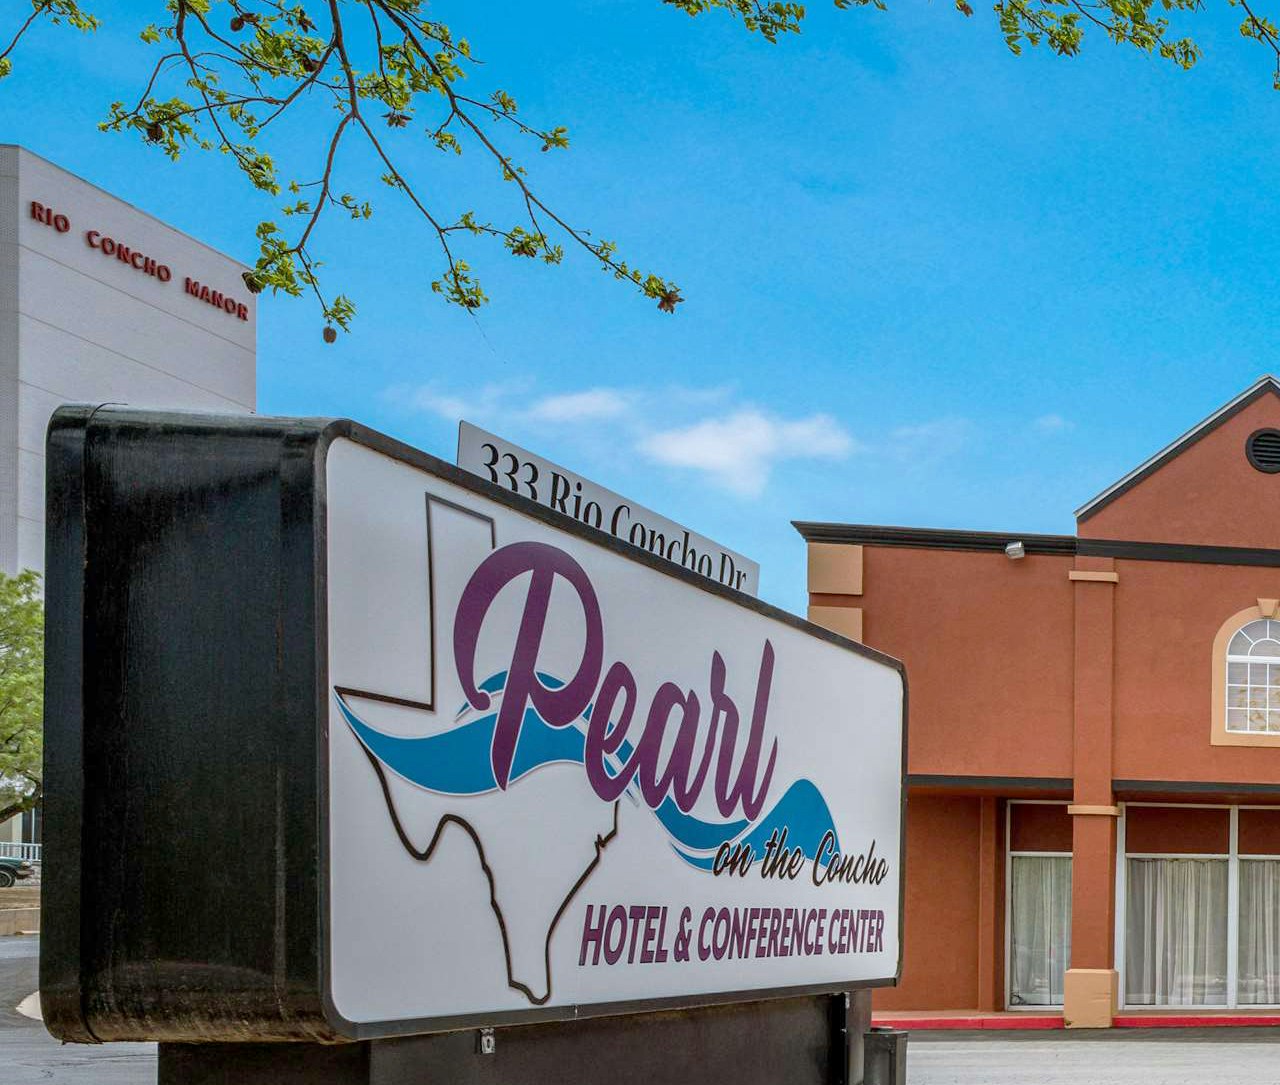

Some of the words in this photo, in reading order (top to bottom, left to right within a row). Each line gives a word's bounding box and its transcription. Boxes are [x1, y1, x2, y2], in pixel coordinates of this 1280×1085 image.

[31, 201, 71, 233] RIO
[87, 231, 172, 282] CONCHO
[185, 277, 249, 321] MANOR
[481, 443, 540, 501] 333
[550, 471, 602, 529] Rio
[611, 505, 713, 579] Concho
[720, 552, 747, 590] Dr
[453, 541, 778, 822] Pearl
[713, 842, 754, 877] on
[761, 826, 805, 880] the
[812, 830, 889, 887] Concho
[579, 905, 668, 966] HOTEL
[674, 906, 692, 961] &
[698, 907, 827, 961] CONFERENCE
[828, 909, 884, 954] CENTER
